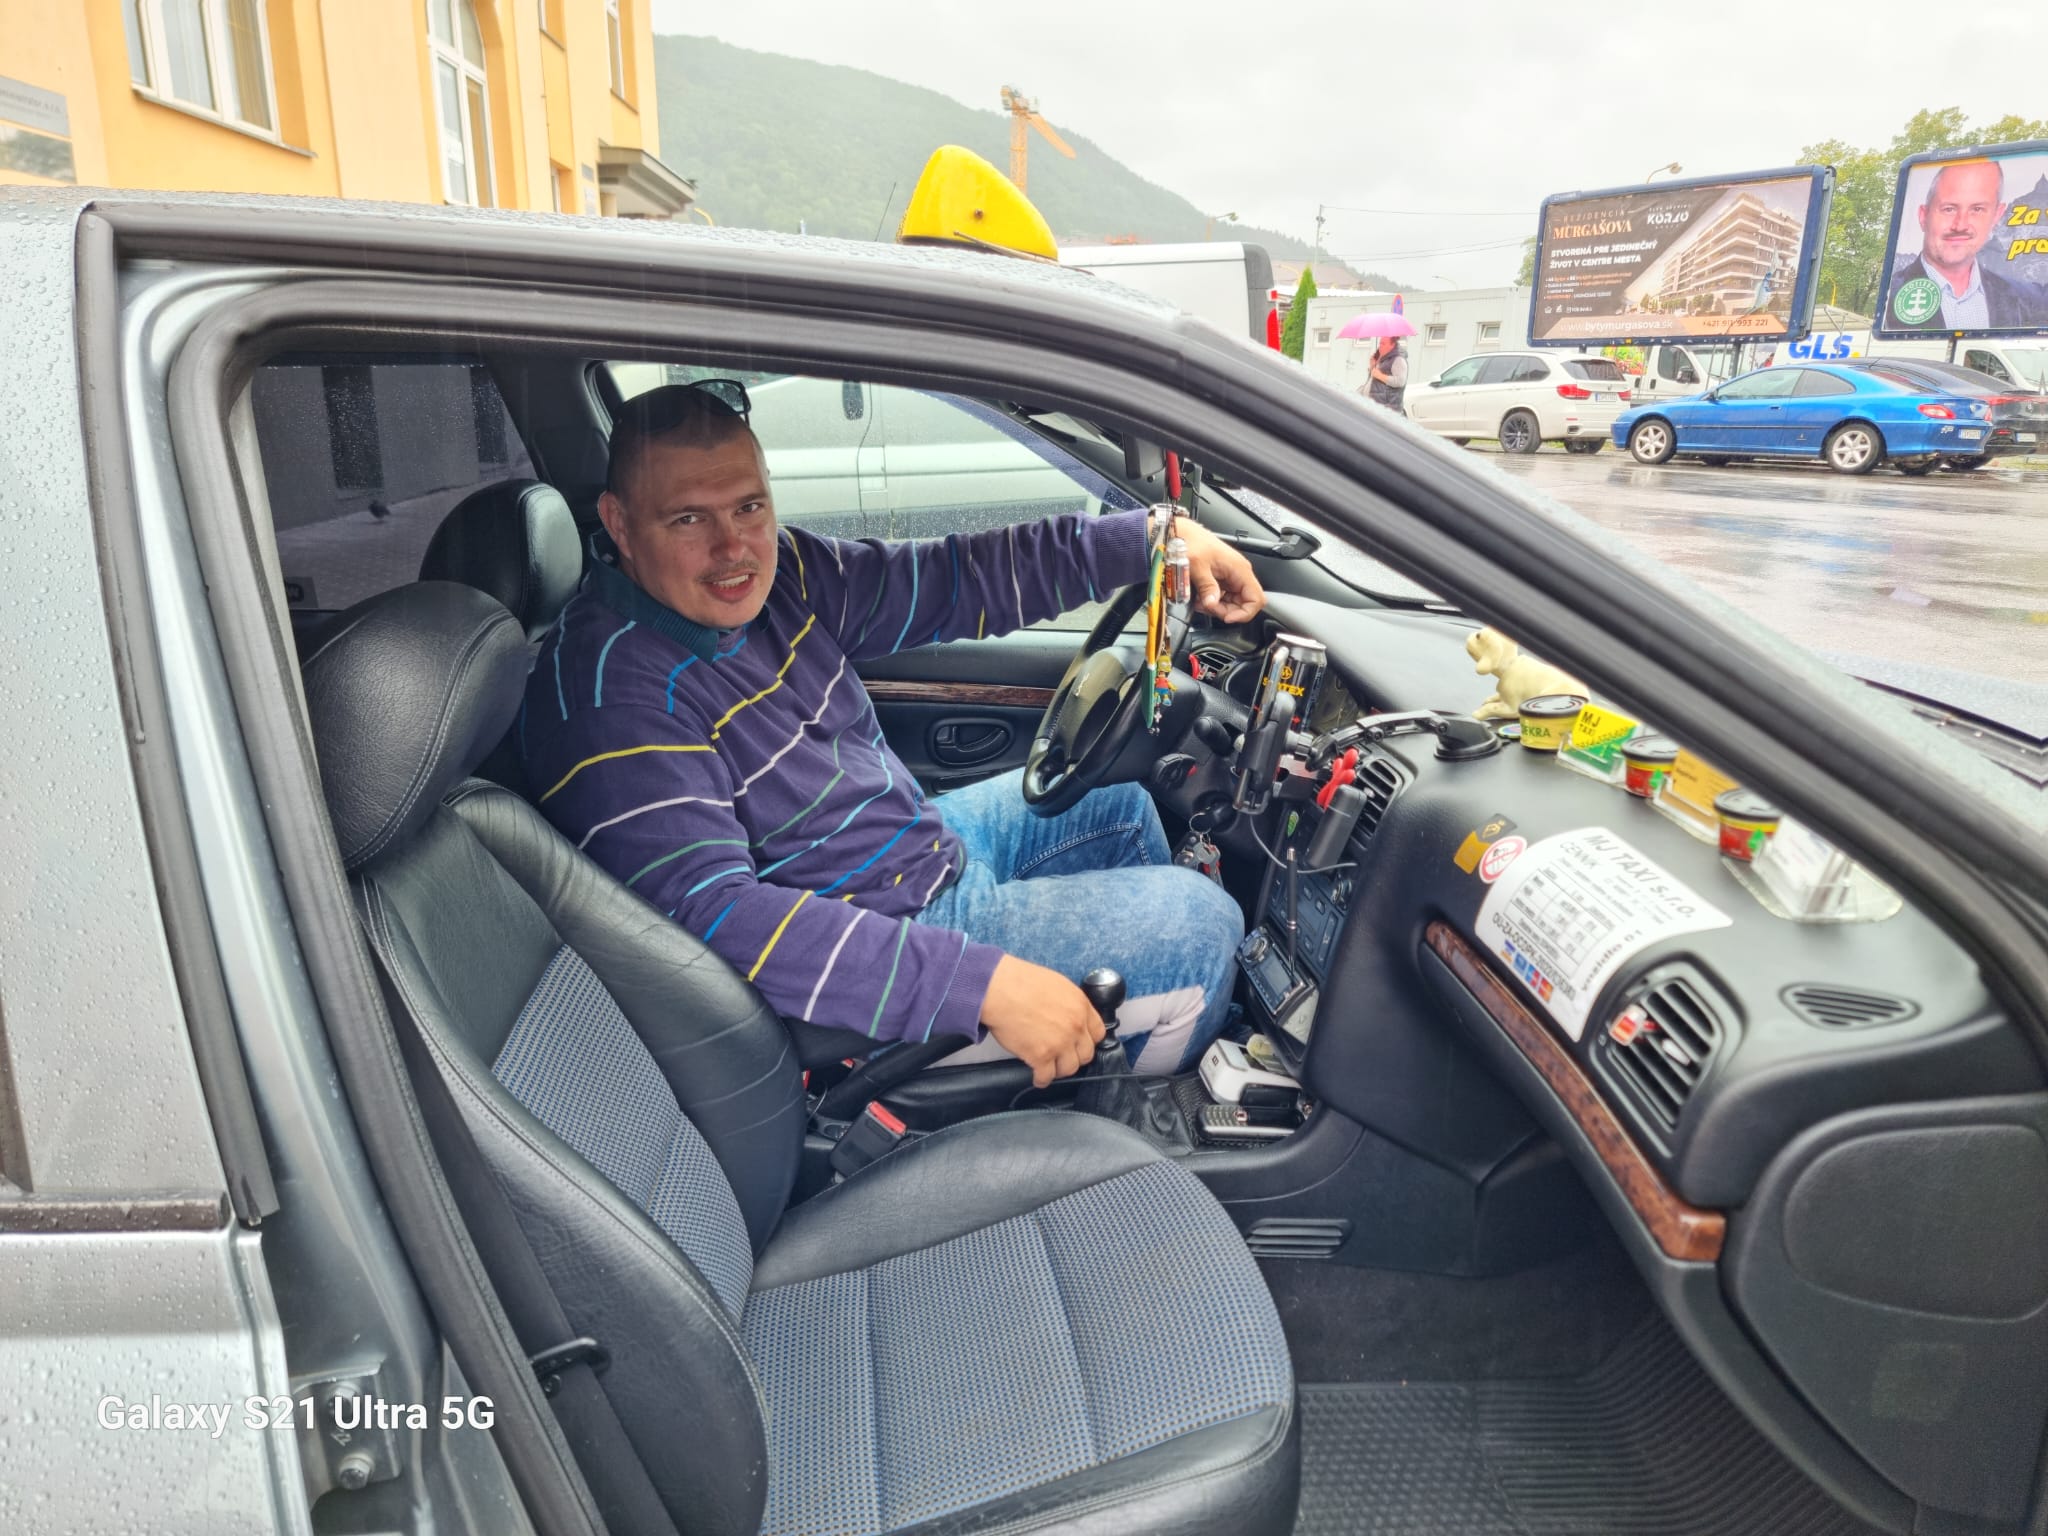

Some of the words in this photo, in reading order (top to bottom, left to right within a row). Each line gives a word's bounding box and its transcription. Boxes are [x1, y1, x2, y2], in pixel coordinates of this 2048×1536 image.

[1562, 209, 1626, 223] REZIDENCIA
[2007, 205, 2040, 226] Za
[1553, 219, 1632, 239] MURGAŠOVA
[1551, 245, 1592, 258] STVORENÁ
[1594, 245, 1609, 254] PRE
[1611, 239, 1658, 253] JEDINEČNÝ
[1549, 259, 1572, 269] ŽIVOT
[1574, 258, 1580, 267] V
[1581, 257, 1612, 267] CENTRE
[1613, 255, 1642, 264] MESTA
[1560, 320, 1673, 333] www.bytymurgasova.sk
[1737, 319, 1753, 327] 993
[1755, 318, 1768, 326] 221
[1581, 711, 1601, 727] MJ
[1584, 834, 1618, 854] MJ
[1611, 854, 1658, 883] TAXI
[1650, 883, 1697, 918] s.r.o.
